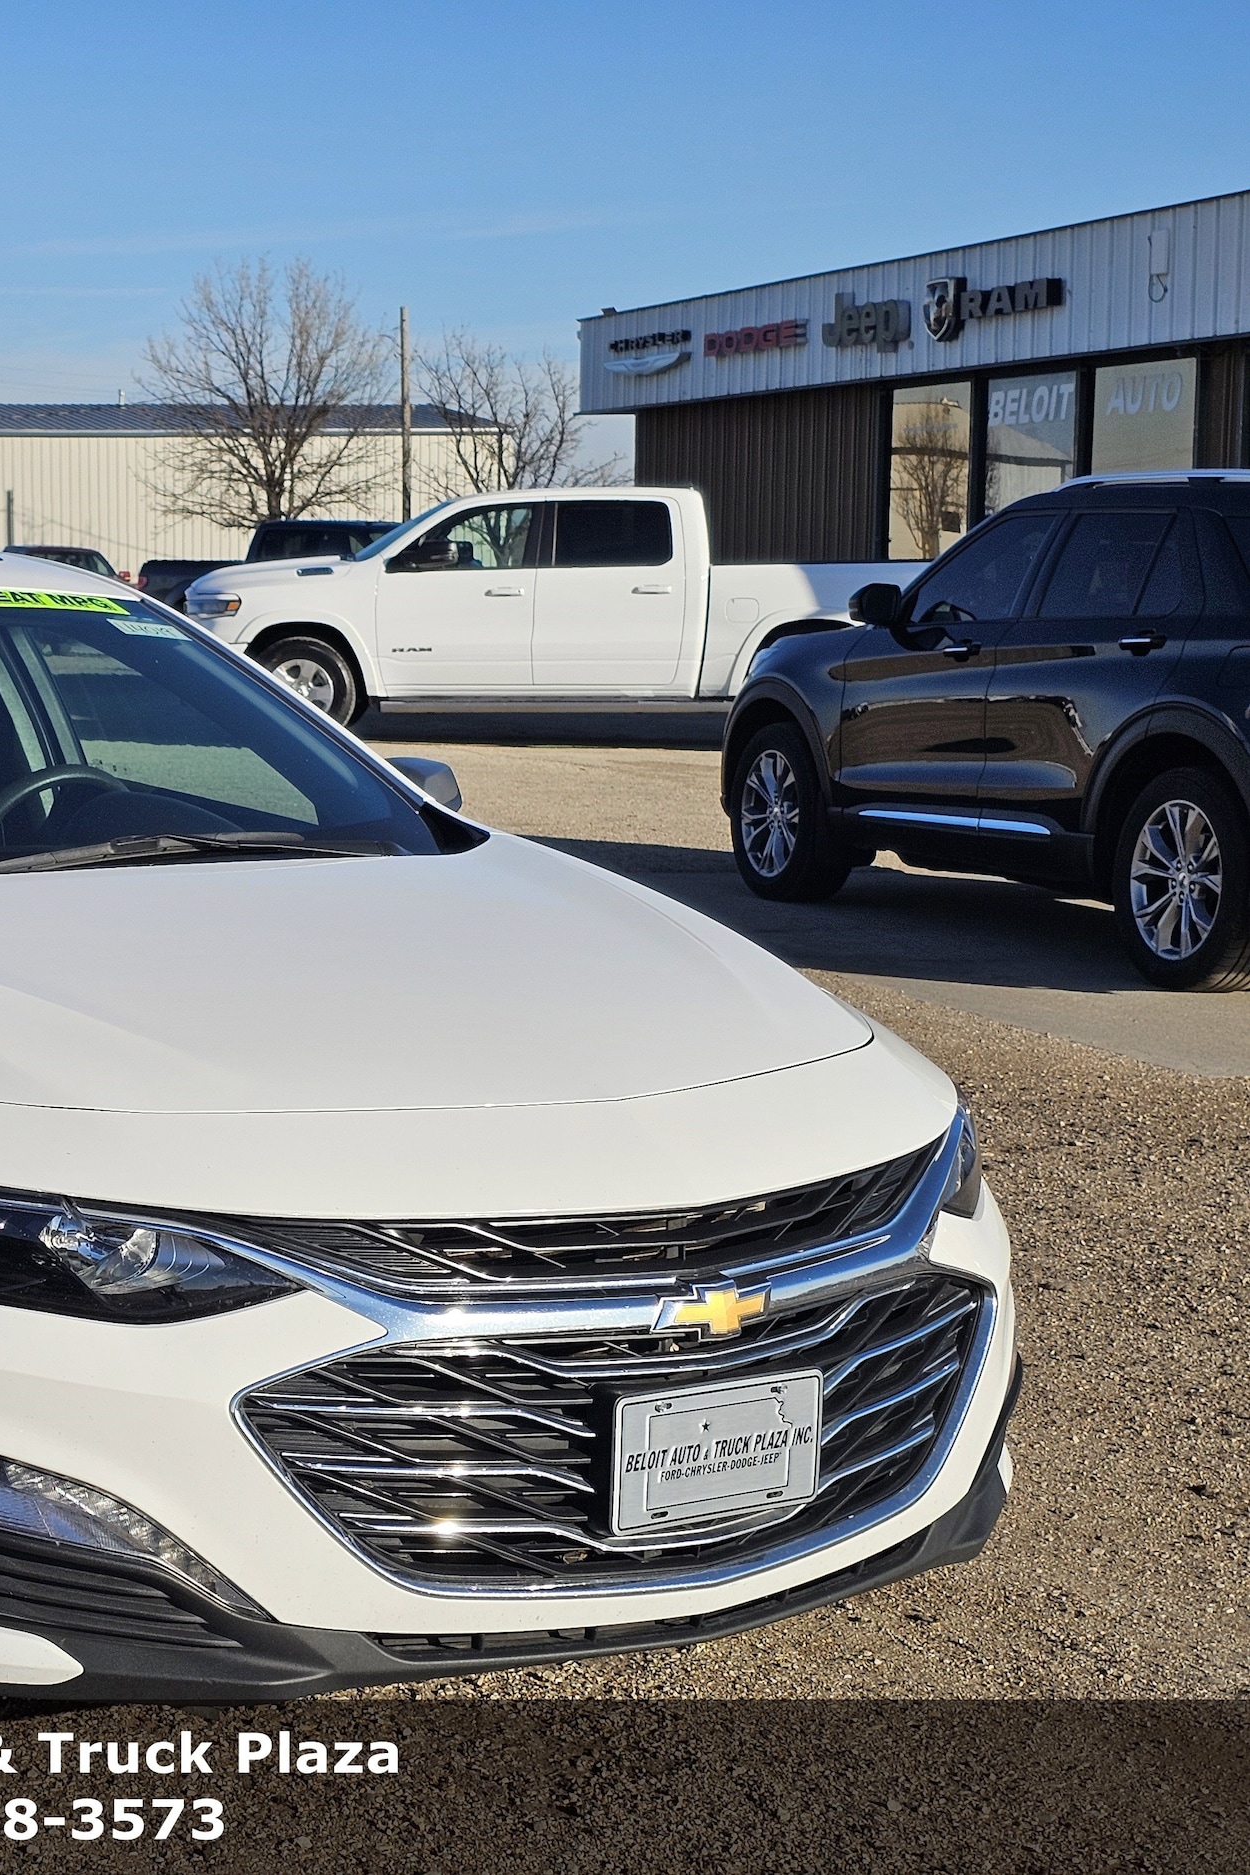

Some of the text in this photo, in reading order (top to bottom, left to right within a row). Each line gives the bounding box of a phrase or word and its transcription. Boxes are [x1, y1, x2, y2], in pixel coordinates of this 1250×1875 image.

[960, 278, 1056, 320] RAM
[609, 329, 691, 352] CHRYSLER
[704, 318, 802, 357] DODGE
[822, 292, 907, 353] Jeep
[988, 372, 1183, 427] BELOIT AUTO
[51, 594, 111, 609] MPG
[625, 1426, 814, 1474] BELOIT AUTO & TRUCK PLAZA INC.
